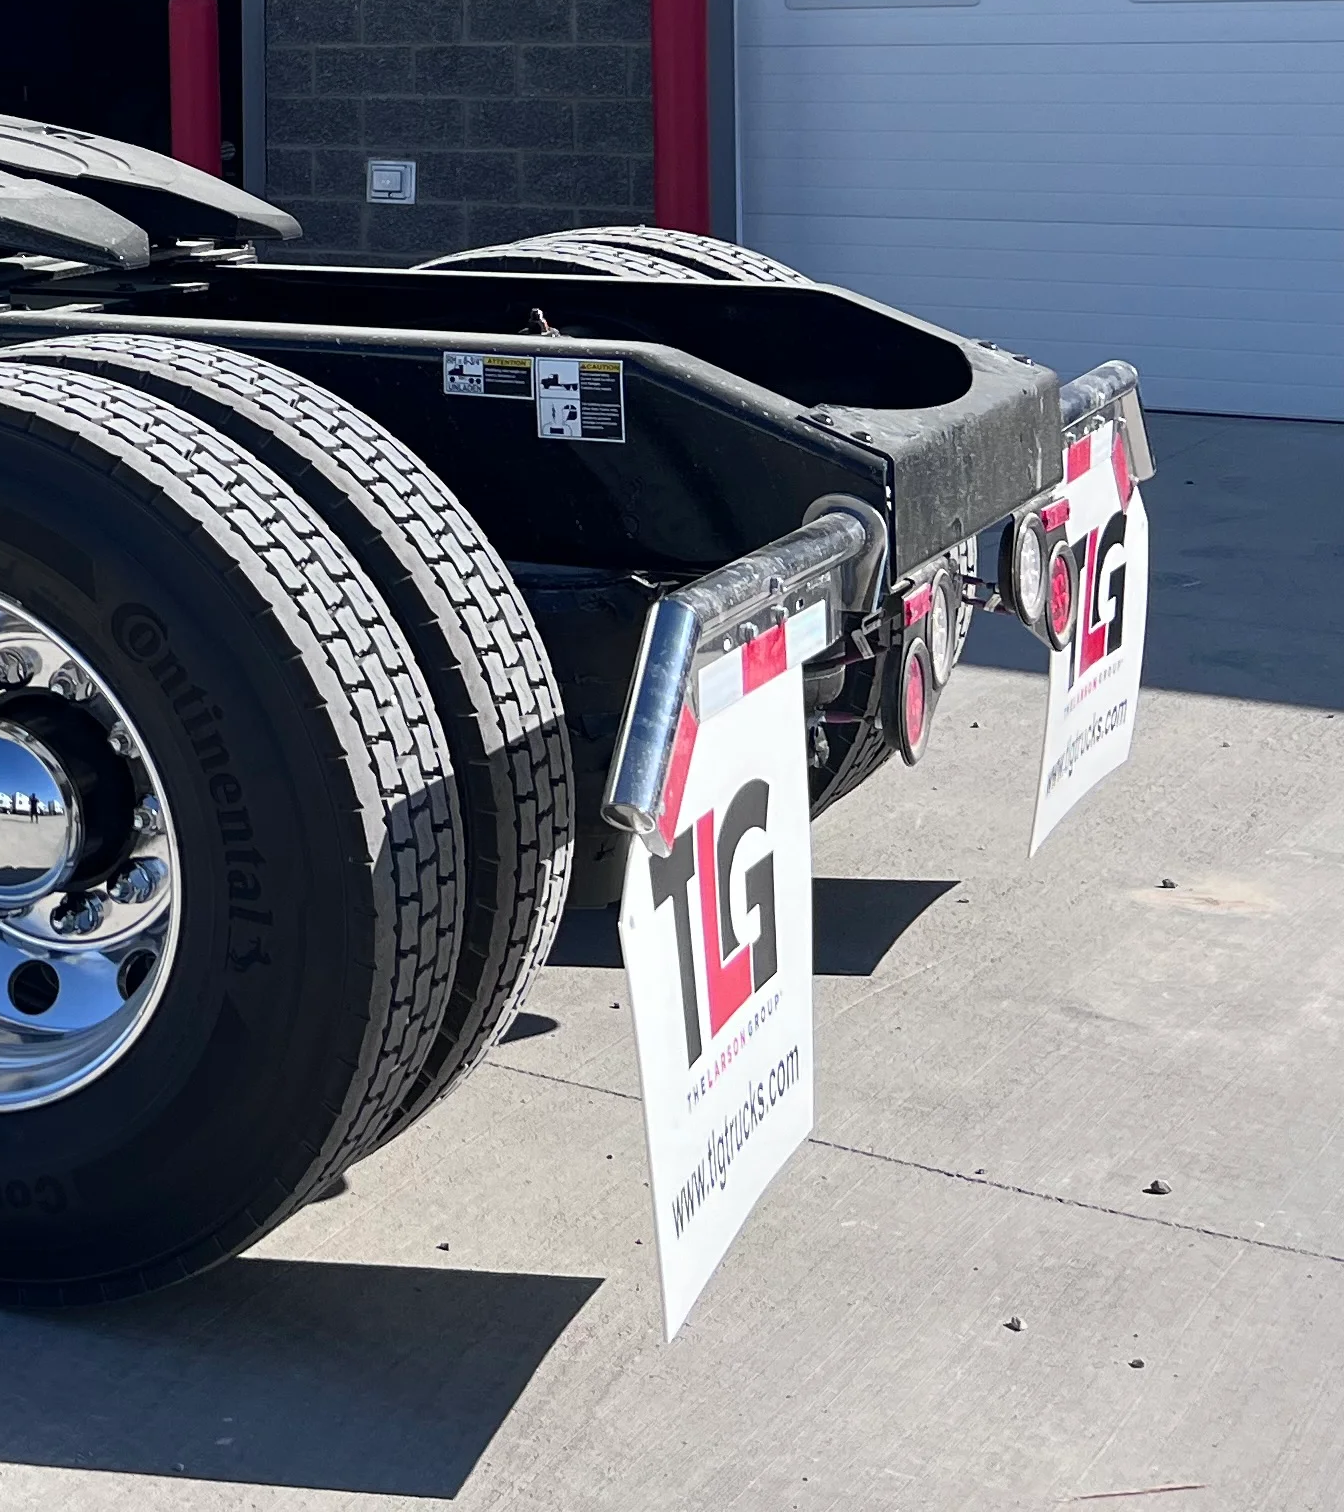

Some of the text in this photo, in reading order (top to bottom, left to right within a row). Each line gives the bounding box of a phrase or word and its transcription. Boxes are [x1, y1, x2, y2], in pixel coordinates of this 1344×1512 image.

[486, 358, 527, 367] ATTENTION
[586, 363, 620, 372] CAUTION
[111, 600, 275, 927] Continental
[648, 777, 779, 1070] TLG
[671, 1043, 800, 1240] www.tlgtrucks.com
